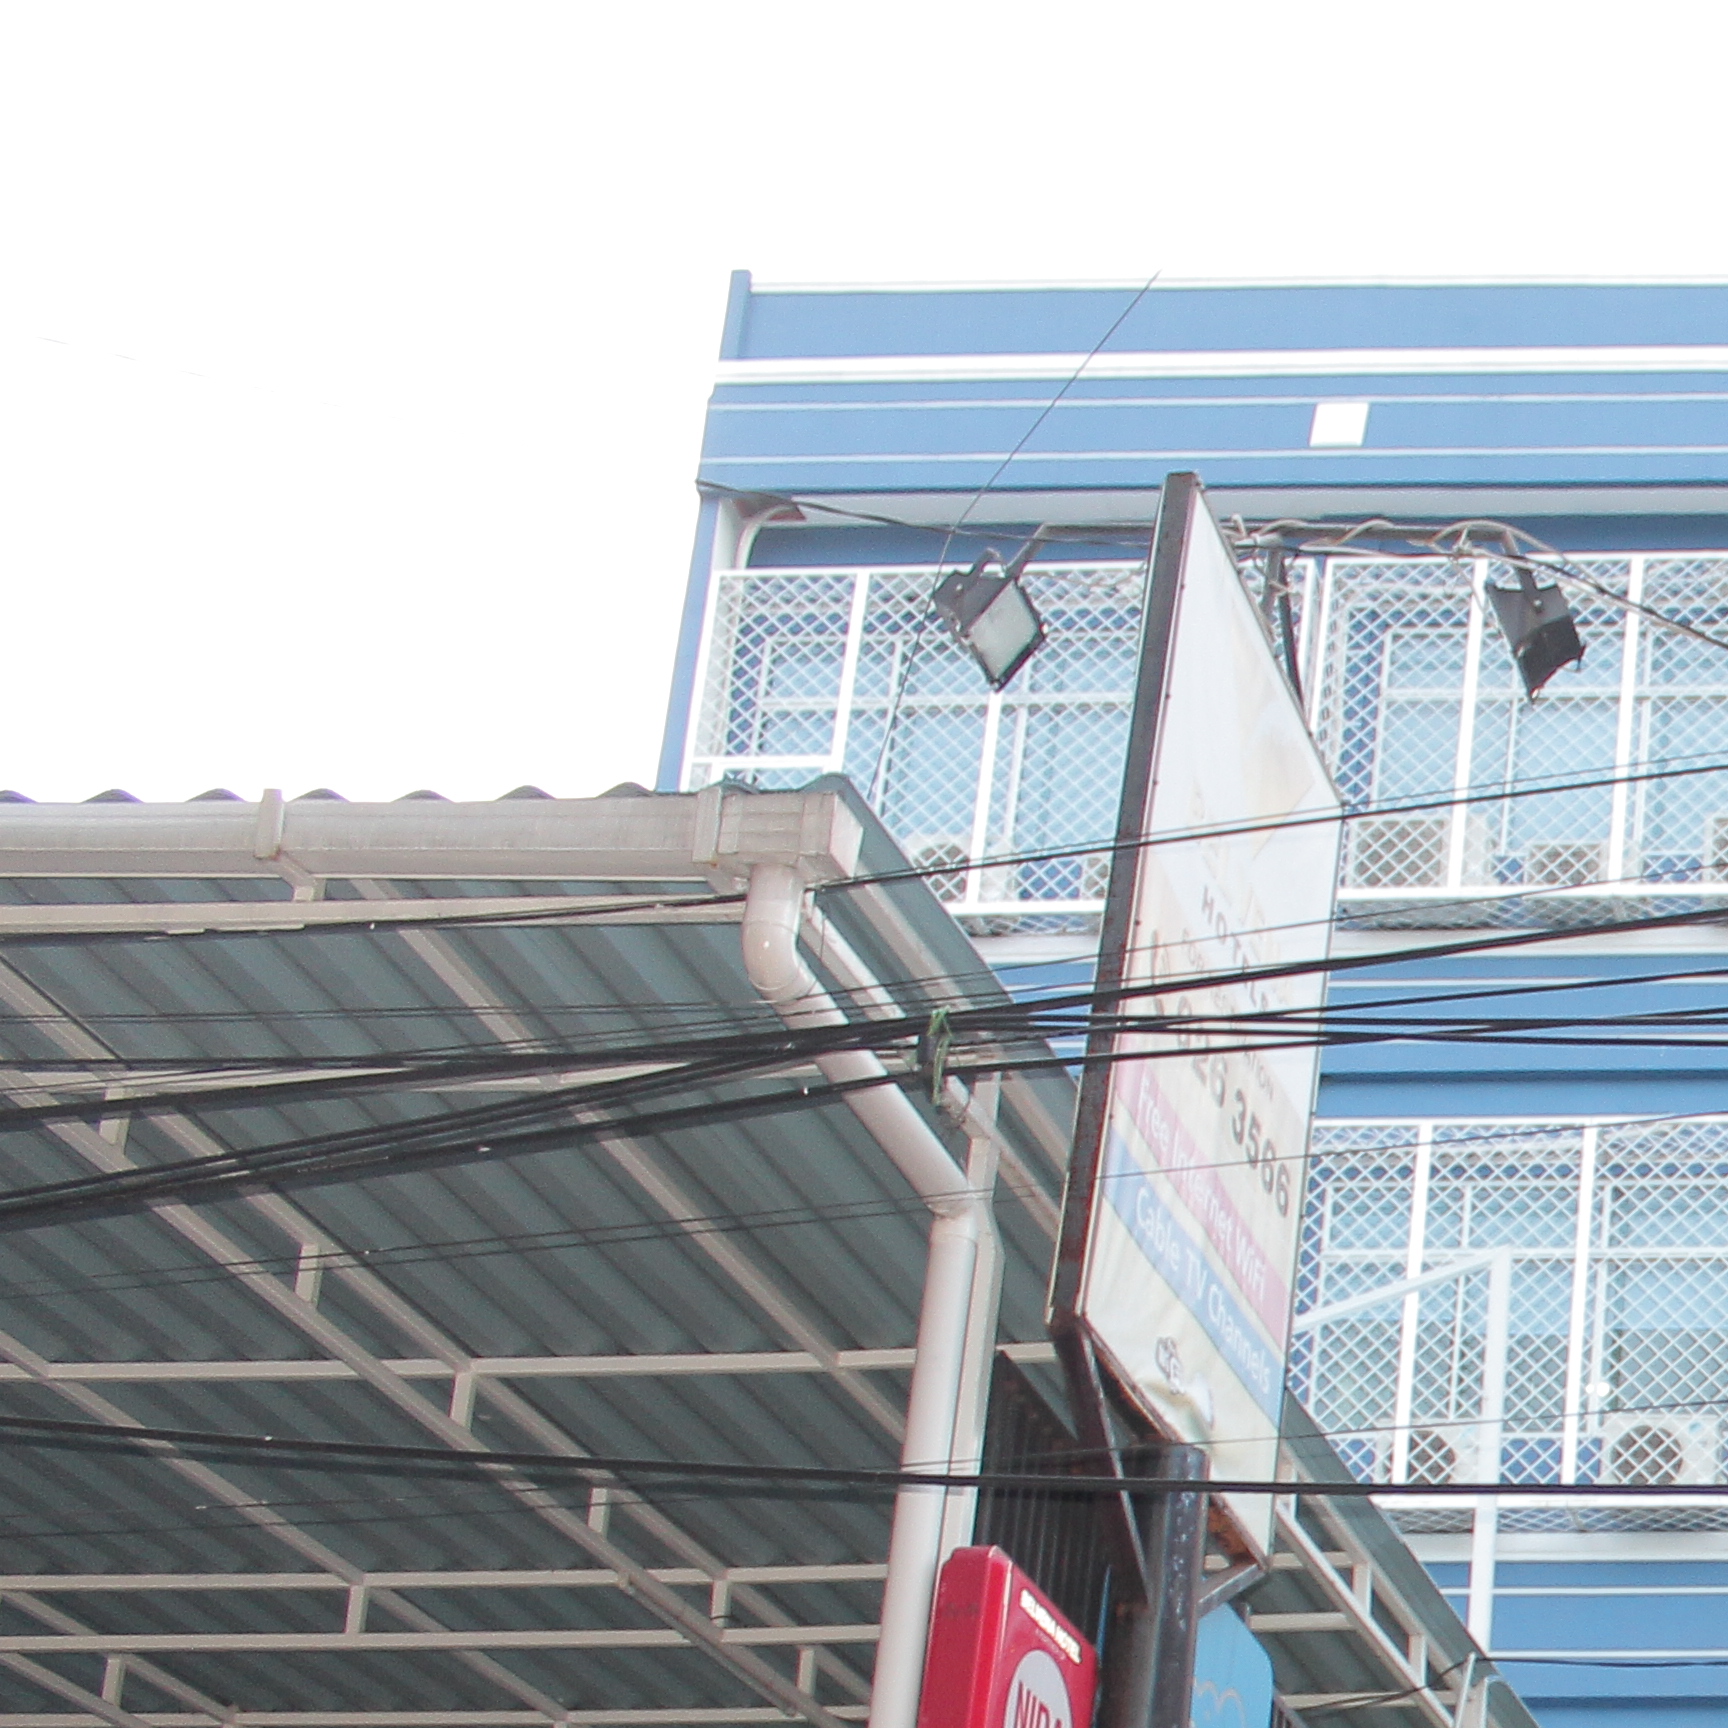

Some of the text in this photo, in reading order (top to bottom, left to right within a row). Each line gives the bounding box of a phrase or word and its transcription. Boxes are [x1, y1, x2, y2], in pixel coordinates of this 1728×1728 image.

[1138, 1073, 1171, 1148] Free
[1136, 1186, 1271, 1395] Cable TV Channels
